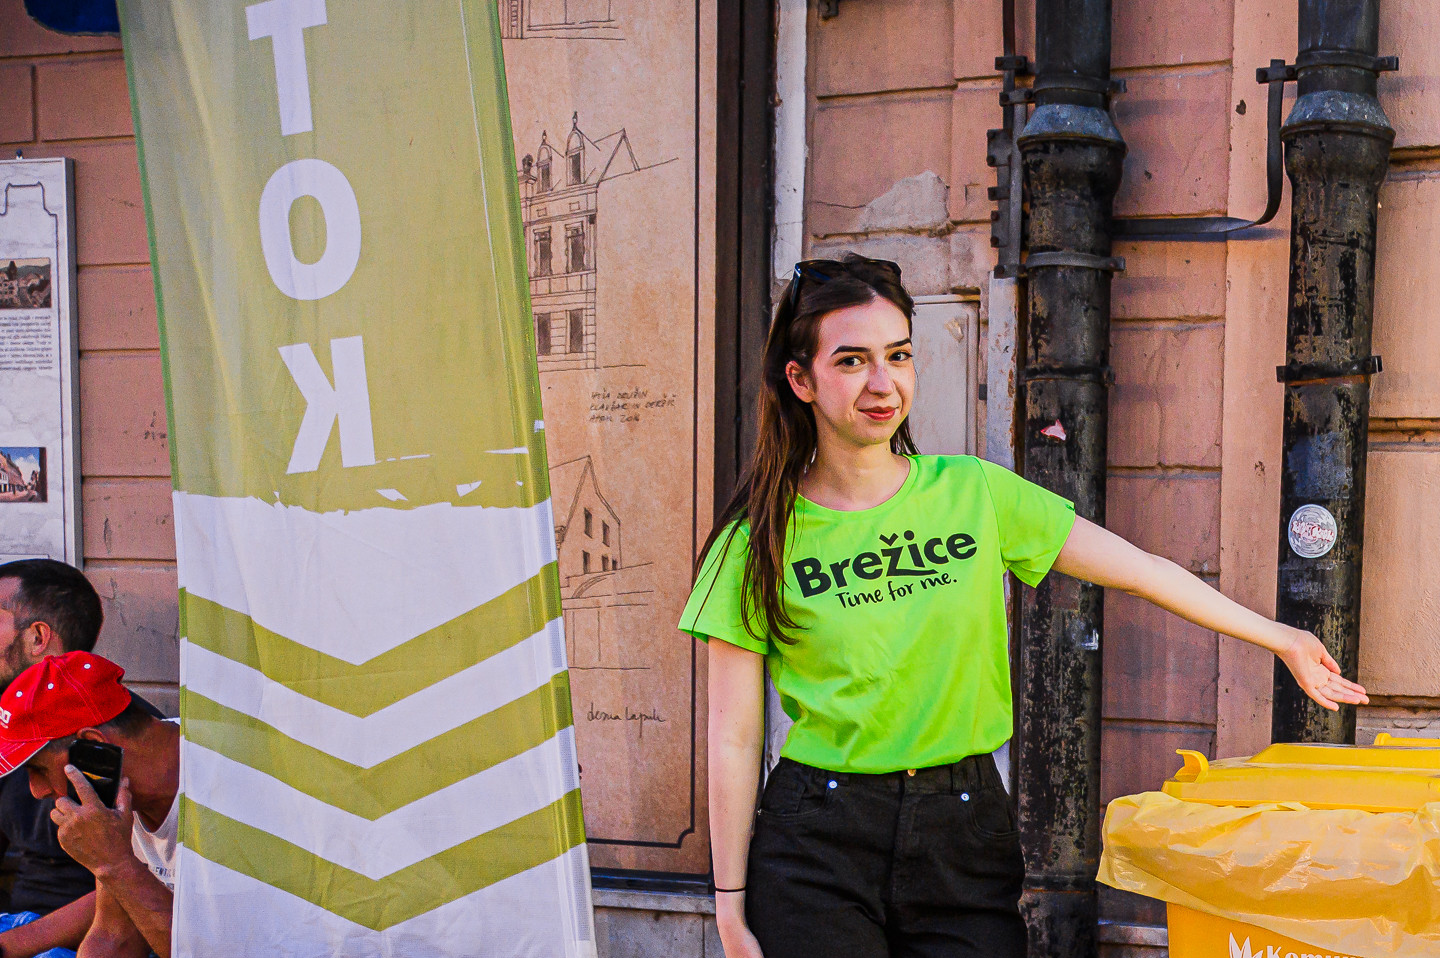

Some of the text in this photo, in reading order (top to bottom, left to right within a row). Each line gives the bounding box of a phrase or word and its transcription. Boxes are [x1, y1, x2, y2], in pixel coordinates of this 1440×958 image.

[791, 529, 978, 598] Brežice
[835, 572, 958, 609] Time for me.
